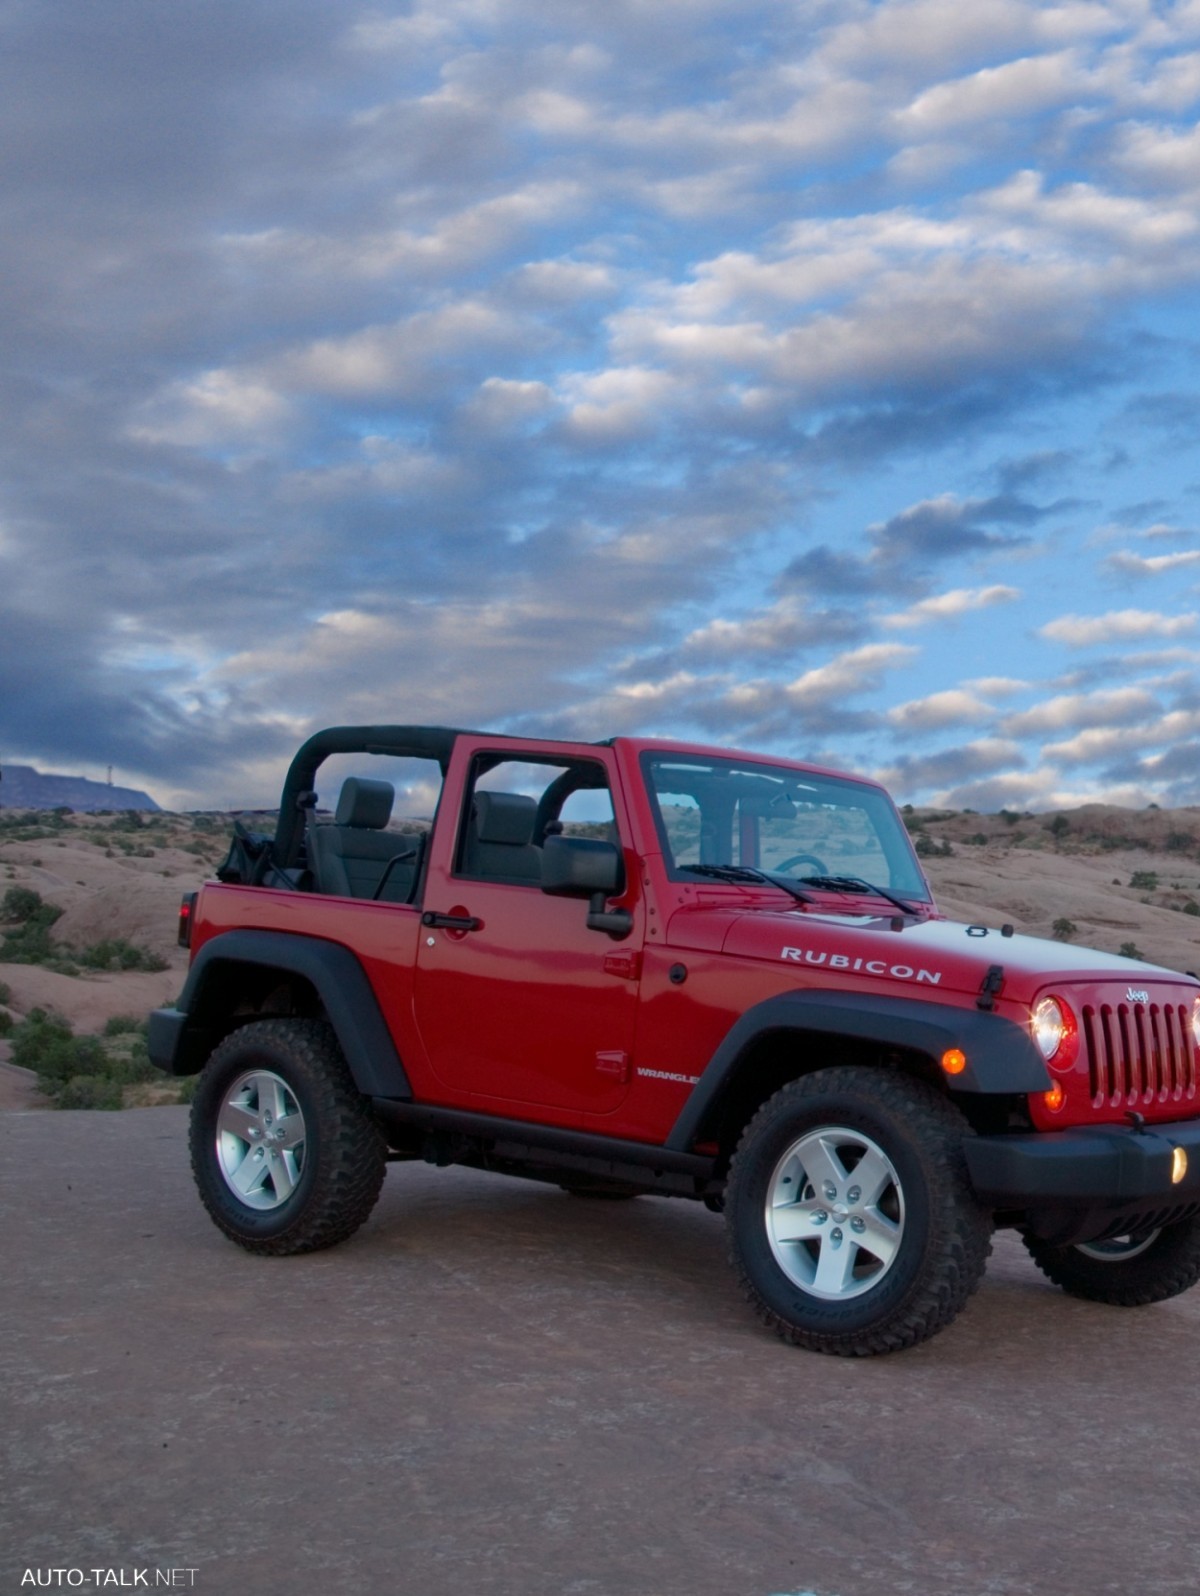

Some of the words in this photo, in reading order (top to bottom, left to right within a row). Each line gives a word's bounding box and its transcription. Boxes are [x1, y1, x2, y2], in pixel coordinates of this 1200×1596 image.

[781, 946, 942, 984] RUBICON
[1126, 986, 1149, 1004] Jeep
[636, 1067, 701, 1084] WRANGLE
